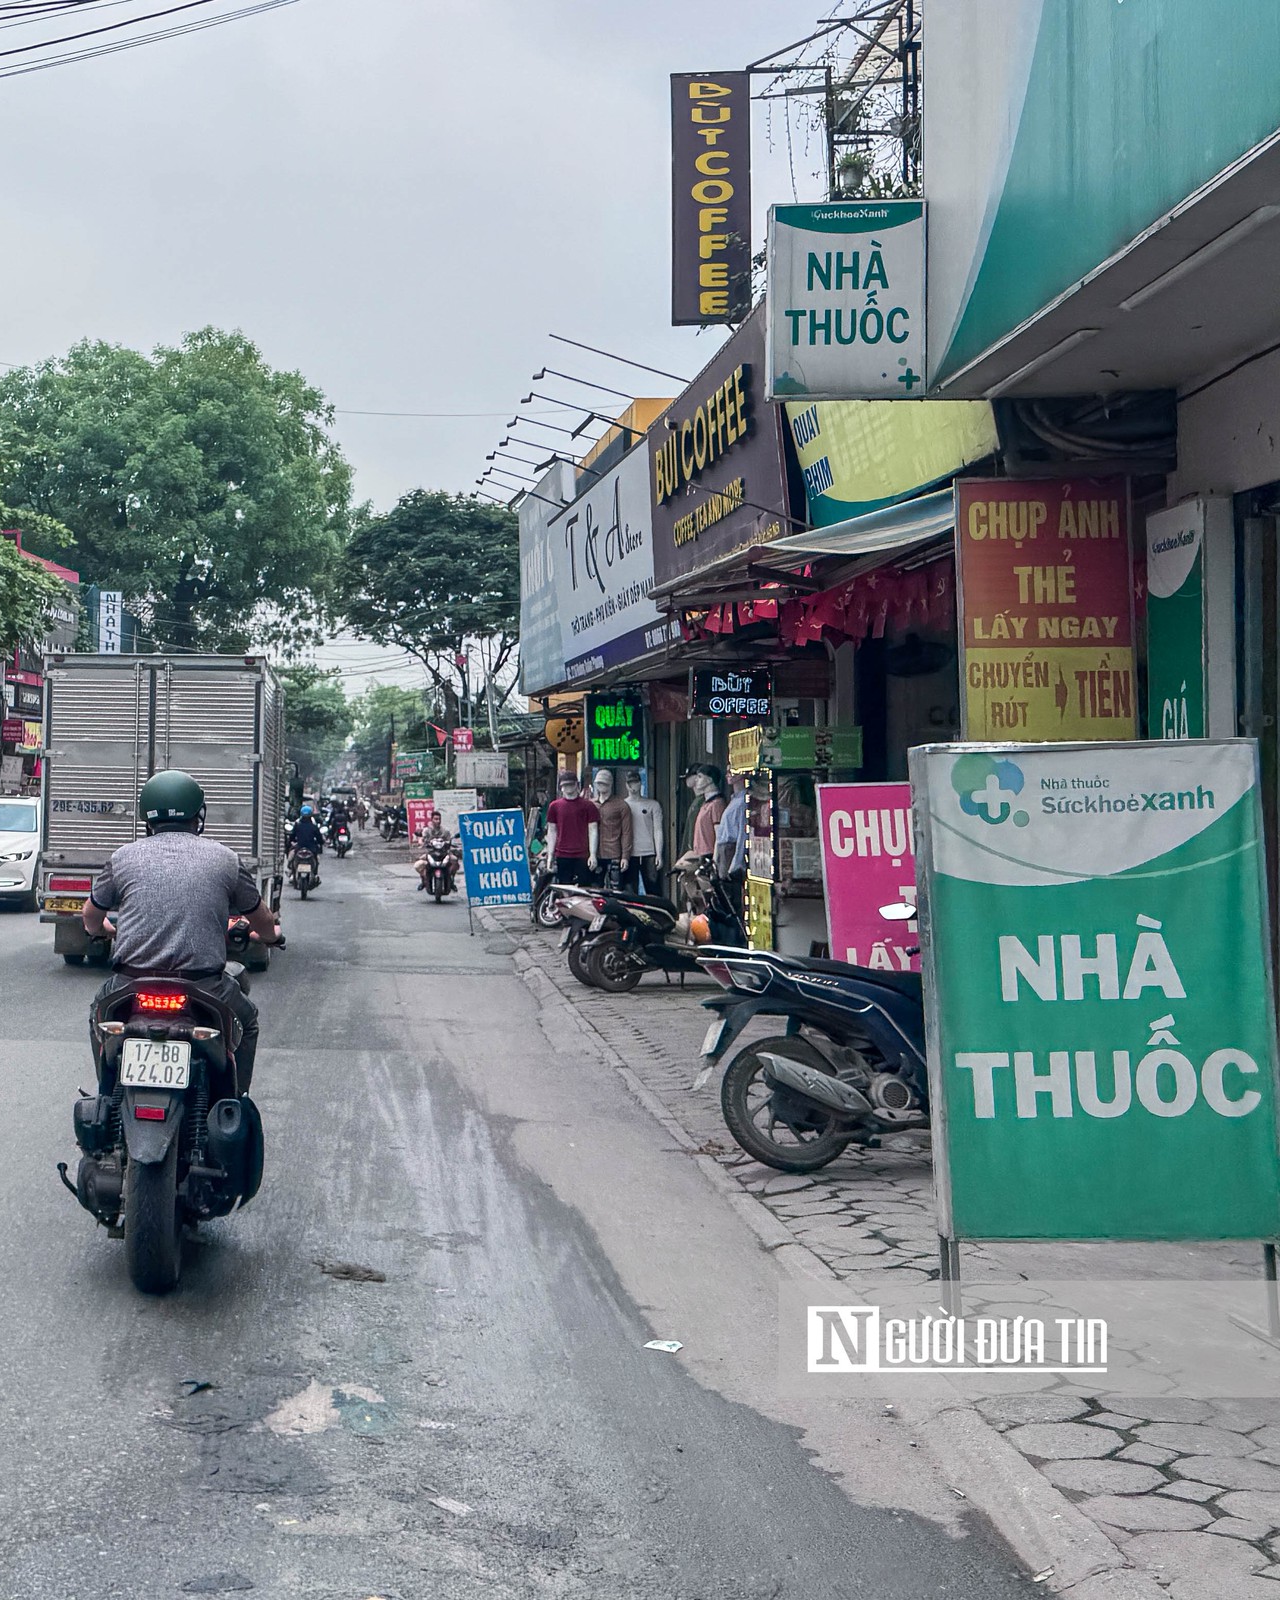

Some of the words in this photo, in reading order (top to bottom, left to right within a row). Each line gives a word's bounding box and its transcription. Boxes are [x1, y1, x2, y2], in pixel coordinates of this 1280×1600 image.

[691, 151, 734, 315] COFFEE
[807, 240, 889, 291] NHÀ
[785, 290, 909, 345] THUỐC
[681, 364, 747, 481] COFFEE
[793, 404, 820, 450] QUAY
[804, 456, 834, 500] PHIM
[565, 512, 578, 592] T
[585, 503, 606, 594] &
[605, 476, 624, 567] A
[969, 500, 1047, 548] CHỤP
[1058, 485, 1120, 538] ẢNH
[1013, 550, 1076, 604] THẺ
[974, 610, 1028, 639] LẤY
[1038, 616, 1119, 639] NGAY
[969, 651, 1050, 689] CHUYỂN
[1074, 653, 1132, 718] TIỀN
[991, 696, 1028, 728] RÚT
[591, 731, 640, 760] THUỐC
[1041, 776, 1067, 790] Nhà
[470, 840, 524, 865] THUỐC
[479, 867, 518, 889] KHÔI
[49, 900, 83, 910] 29E-435
[999, 913, 1187, 1002] NHÀ
[125, 1064, 185, 1085] 424.02
[135, 1043, 180, 1063] 17-B8
[955, 1013, 1262, 1119] THUỐC
